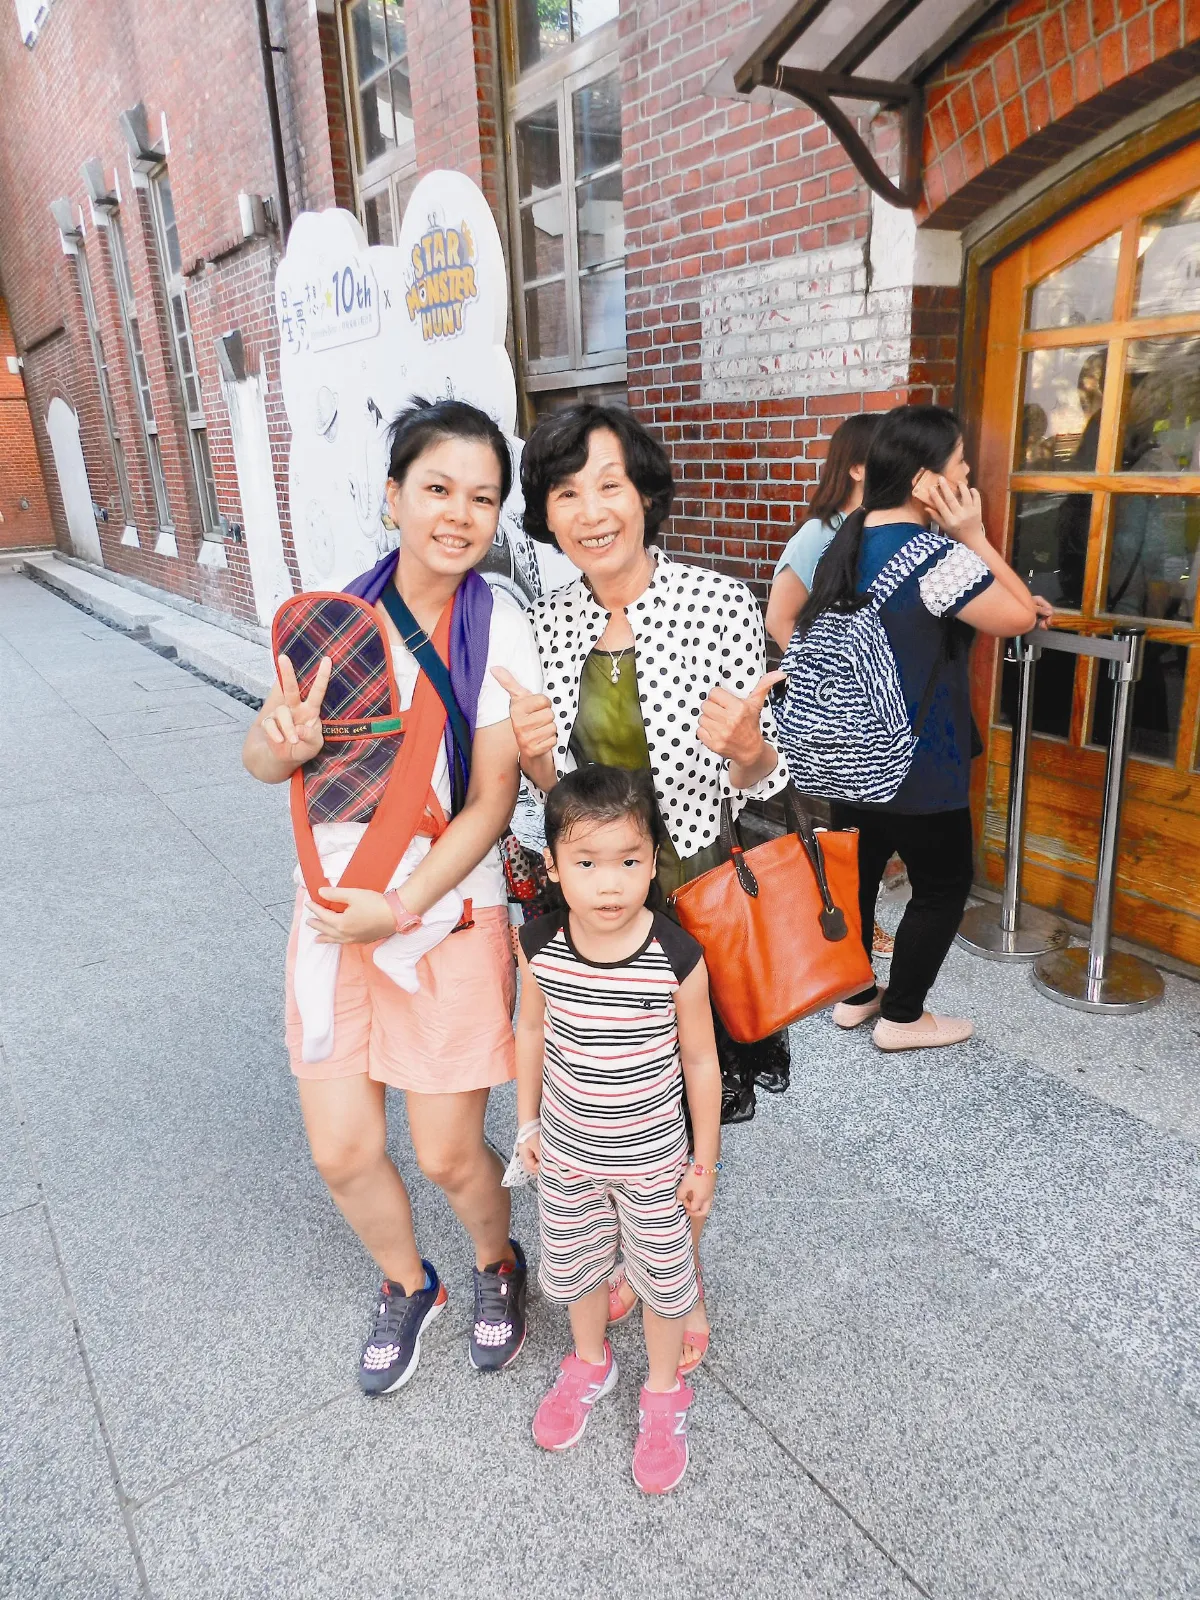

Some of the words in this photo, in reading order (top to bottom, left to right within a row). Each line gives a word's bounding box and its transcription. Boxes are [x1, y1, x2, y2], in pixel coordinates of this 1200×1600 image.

[412, 228, 461, 280] STAR
[332, 266, 371, 317] 10th
[405, 264, 477, 321] MONSTER
[421, 301, 462, 341] HUNT
